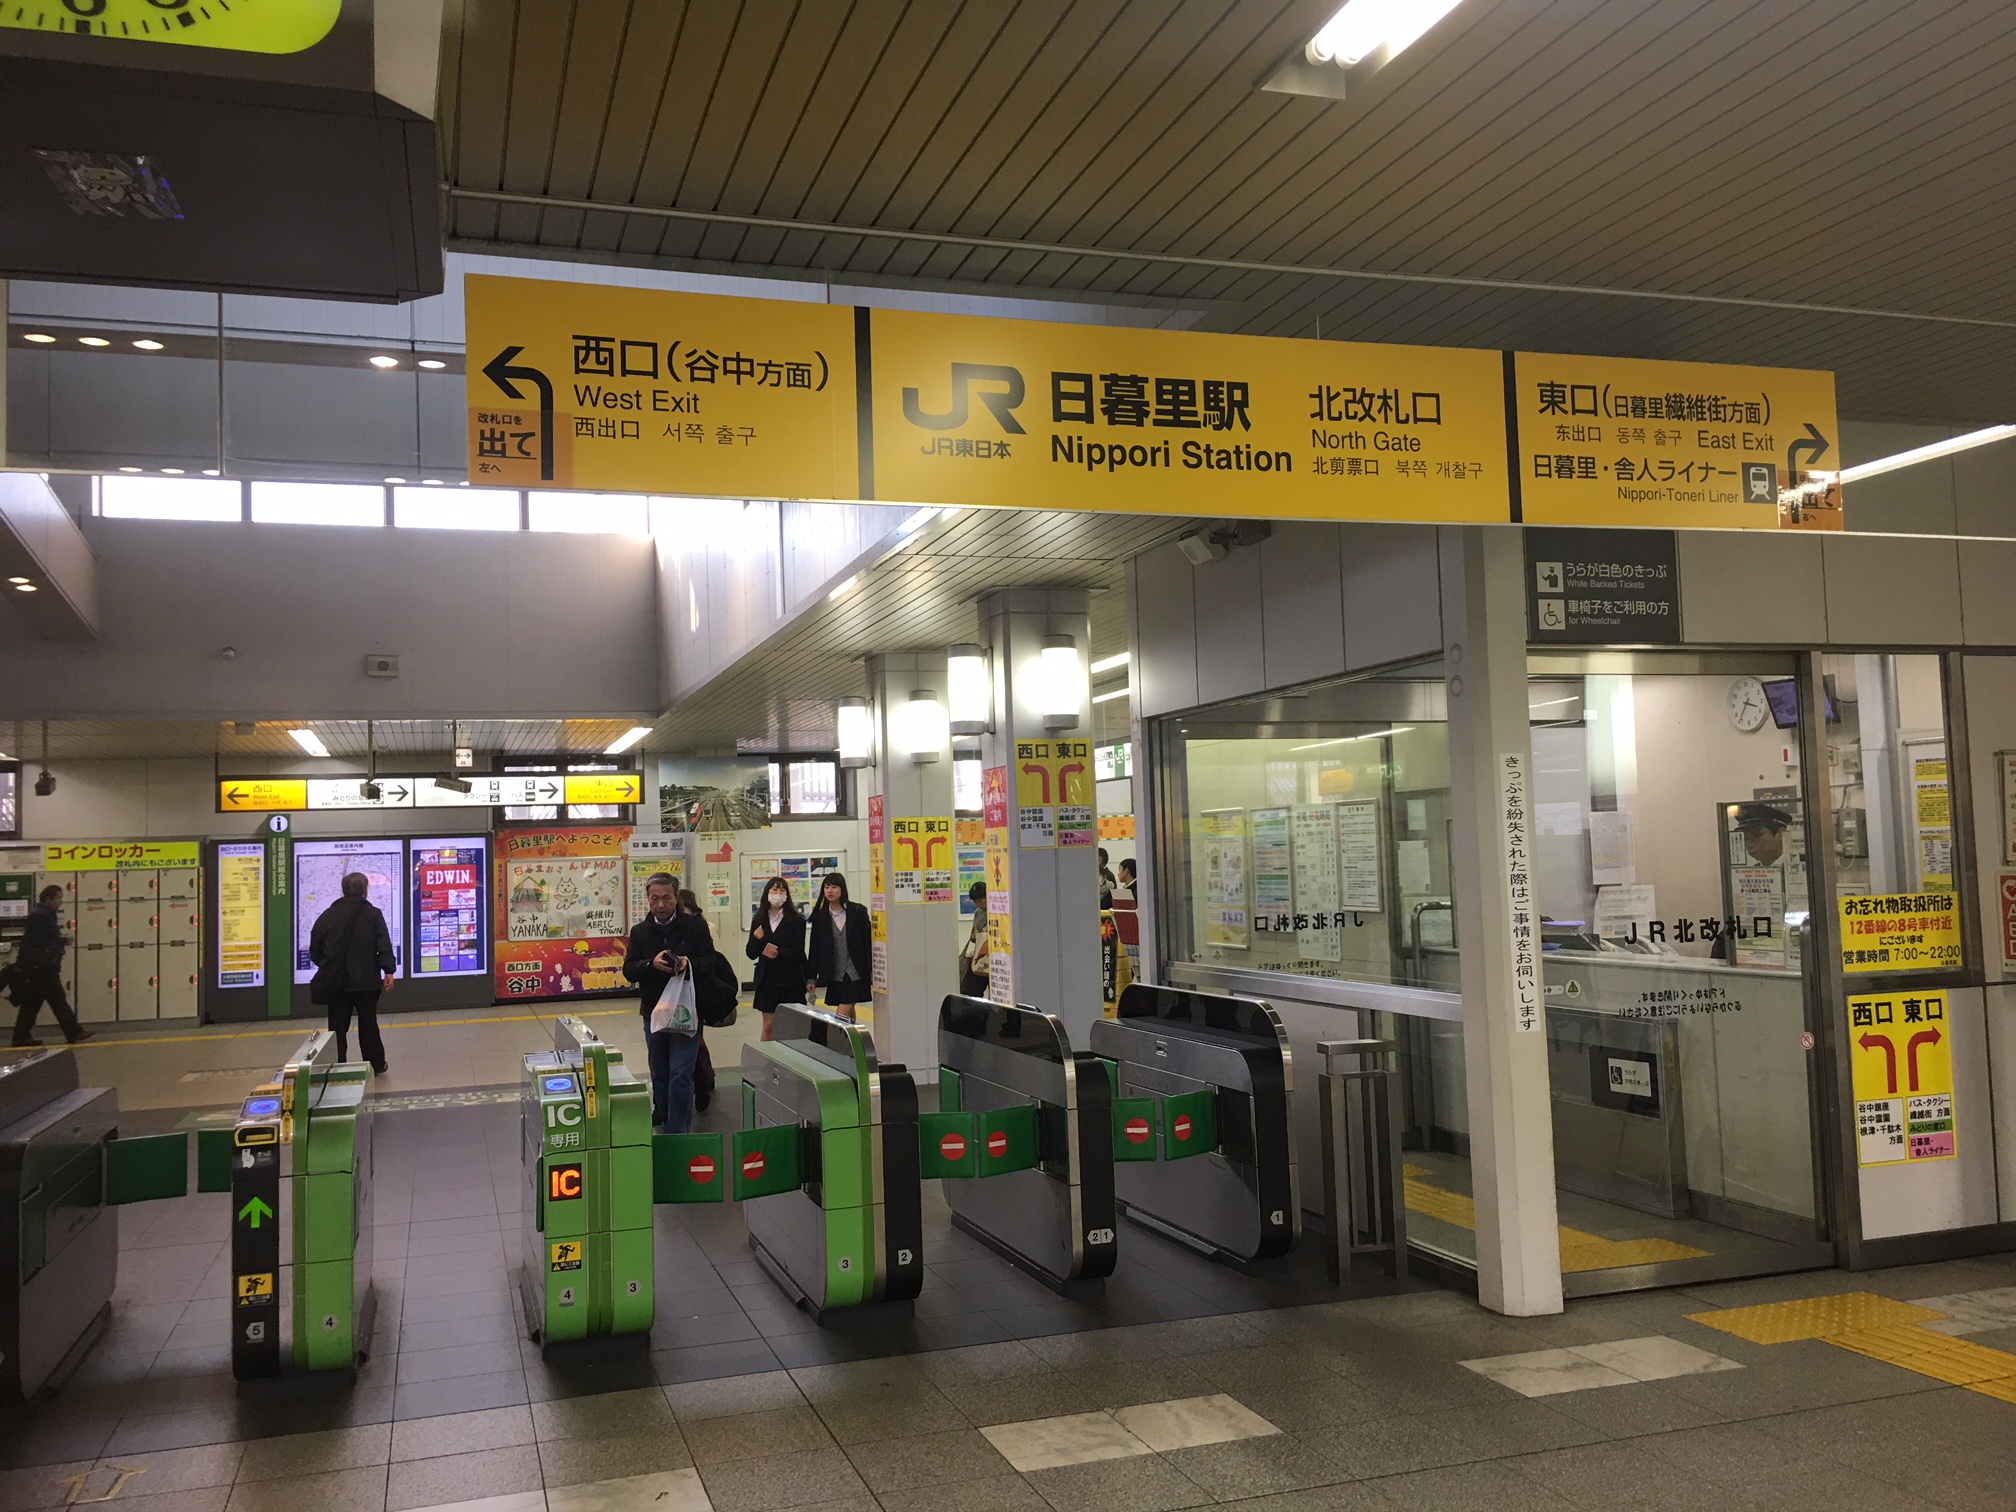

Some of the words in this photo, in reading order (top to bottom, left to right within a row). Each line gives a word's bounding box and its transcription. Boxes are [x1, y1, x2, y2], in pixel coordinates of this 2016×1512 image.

[572, 334, 829, 392] 西口(谷中方面)
[574, 385, 642, 411] West
[652, 390, 700, 414] Exit
[902, 362, 1026, 435] JR
[1051, 371, 1251, 433] 日暮里駅
[1308, 385, 1443, 425] 北改札口
[477, 412, 522, 426] 改札口を
[574, 417, 640, 440] 西出口
[663, 423, 705, 444] 서쪽
[715, 424, 757, 446] 출구
[1555, 424, 1602, 443] 东出口
[1616, 427, 1646, 445] 동쪽
[1654, 428, 1683, 447] 출구
[1698, 430, 1737, 451] East
[1743, 432, 1774, 452] Exit
[477, 428, 536, 458] 出て
[920, 436, 1012, 459] JR東日本
[1312, 429, 1367, 451] North
[1374, 431, 1421, 453] Gate
[1051, 433, 1171, 472] Nippori
[1182, 442, 1292, 472] Station
[478, 462, 501, 474] 左へ
[1312, 456, 1380, 477] 北剪票口
[1395, 459, 1428, 479] 북쪽
[1435, 460, 1485, 480] 개찰구
[1533, 454, 1737, 484] 日暮里・舎人ライナー
[1617, 486, 1705, 503] Nippori-Toneri
[1708, 489, 1739, 504] Liner
[1803, 512, 1817, 521] 右へ
[1566, 562, 1667, 579] うらが白色のきっぷ
[1567, 579, 1587, 590] White
[1589, 579, 1617, 590] Backed
[1618, 580, 1645, 590] Tickets
[1567, 600, 1669, 616] 車椅子をご利用の方
[1568, 616, 1578, 626] for
[1580, 616, 1621, 626] Wheelchair
[1018, 743, 1049, 759] 西口
[1056, 742, 1087, 759] 東口
[252, 784, 272, 793] 西口
[893, 820, 919, 834] 西口
[925, 820, 949, 833] 東口
[47, 844, 161, 860] コインロッカー
[632, 841, 668, 849] 日暮里駅
[115, 858, 197, 868] 改札内にもございます
[594, 860, 617, 870] MAP
[426, 869, 471, 885] EDWIN
[1504, 755, 1540, 1031] きっぷを紛失された際はご事情をお伺いします
[1845, 894, 1953, 916] お忘れ物取扱所は
[516, 913, 539, 924] 谷中
[1850, 916, 1952, 934] 12番線の8号車付近
[511, 924, 548, 937] YANAKA
[598, 927, 623, 936] TOWN
[1625, 916, 1772, 945] JR北改札口
[1879, 934, 1924, 946] にございます
[1843, 948, 1890, 964] 営業時間
[506, 962, 541, 972] 西口方面
[507, 976, 541, 993] 谷中
[1852, 1001, 1893, 1027] 西口
[1902, 998, 1943, 1023] 東口
[1858, 1101, 1890, 1113] 谷中銀座
[1909, 1097, 1950, 1108] バス・タクシー
[547, 1103, 582, 1128] IC
[1859, 1113, 1891, 1125] 谷中霊園
[1937, 1107, 1950, 1118] 方面
[1860, 1124, 1902, 1136] 根津・千駄木
[1910, 1122, 1945, 1133] みどりの窓口
[550, 1131, 579, 1148] 専用
[1889, 1135, 1904, 1145] 方面
[1910, 1137, 1933, 1147] 日暮里・
[1915, 1146, 1950, 1156] 舎人ライナー
[552, 1169, 580, 1196] IC
[1275, 1213, 1281, 1222] 1
[1092, 1232, 1099, 1241] 2
[1103, 1231, 1108, 1240] 1
[841, 1259, 849, 1269] 3
[901, 1252, 908, 1262] 2
[629, 1282, 637, 1292] 3
[563, 1290, 571, 1299] 4
[325, 1317, 333, 1327] 4
[252, 1325, 261, 1336] 5
